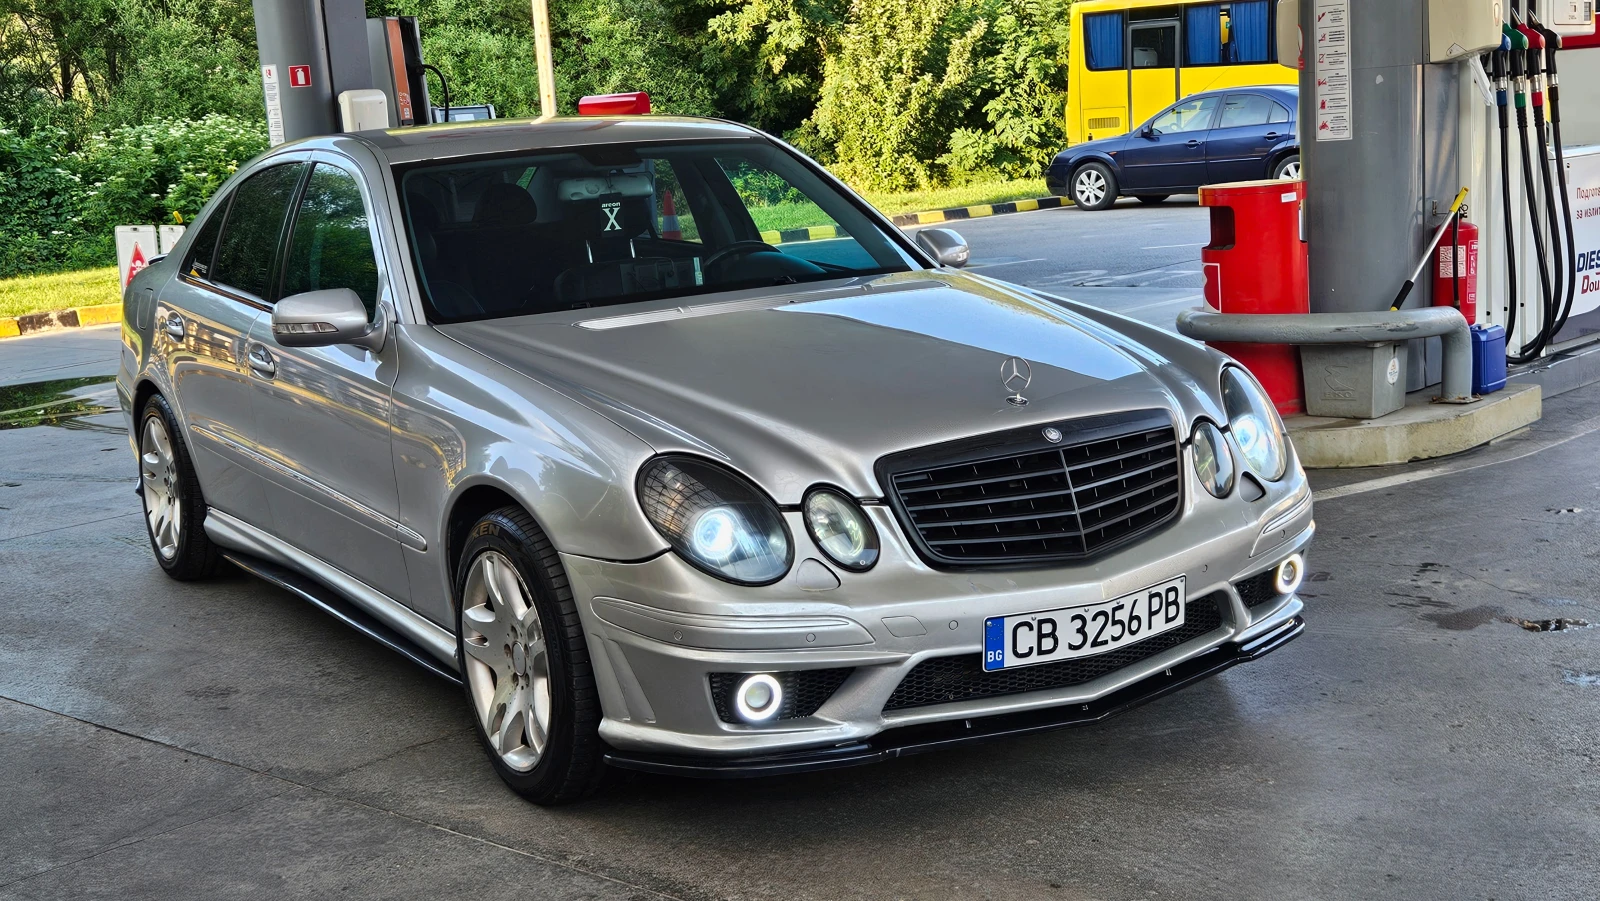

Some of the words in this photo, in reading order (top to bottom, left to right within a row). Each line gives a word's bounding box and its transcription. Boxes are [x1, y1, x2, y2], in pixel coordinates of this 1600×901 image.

[602, 207, 622, 231] X
[1576, 209, 1583, 219] за
[1012, 617, 1059, 659] CB
[1067, 598, 1142, 651] 3256
[1147, 585, 1180, 631] PB
[987, 650, 1003, 663] BG
